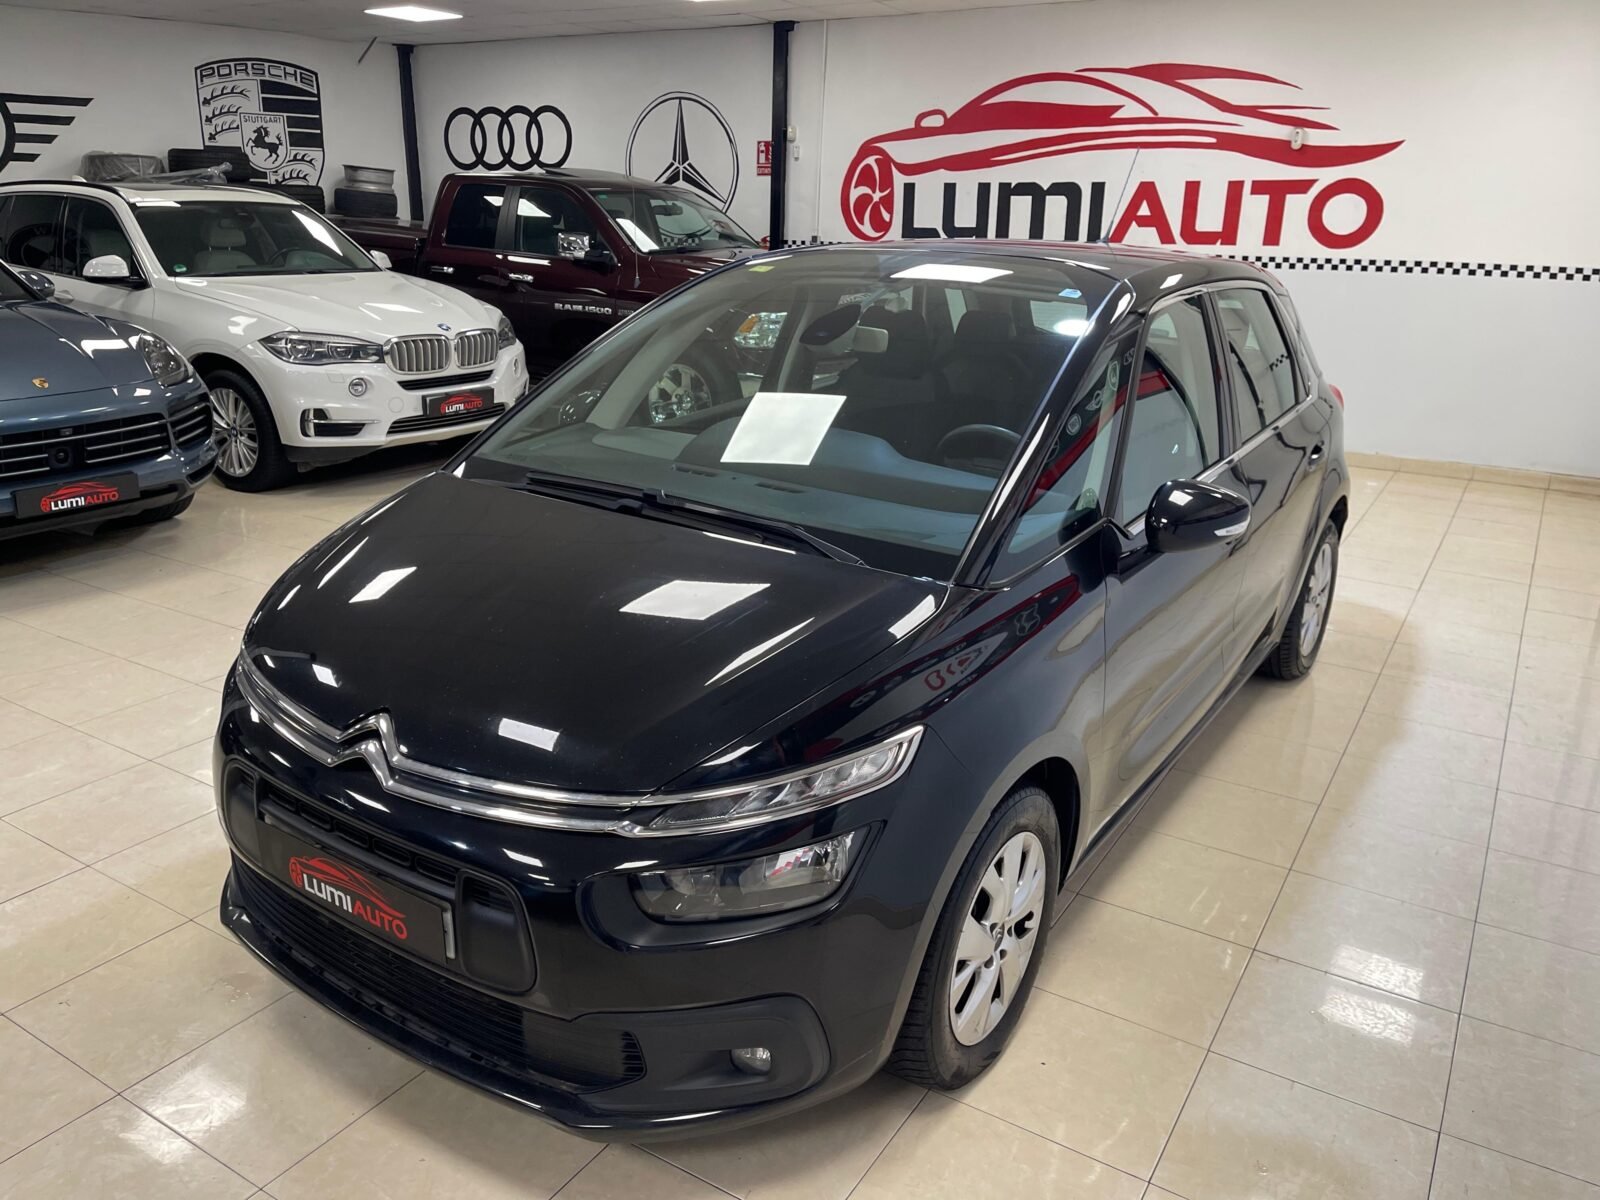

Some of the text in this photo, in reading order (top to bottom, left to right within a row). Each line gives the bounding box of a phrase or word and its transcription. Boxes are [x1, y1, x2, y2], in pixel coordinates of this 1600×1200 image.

[199, 62, 316, 90] PORSCHE
[243, 115, 281, 124] STUTTGART
[554, 302, 583, 312] RAM
[584, 305, 612, 315] 1500
